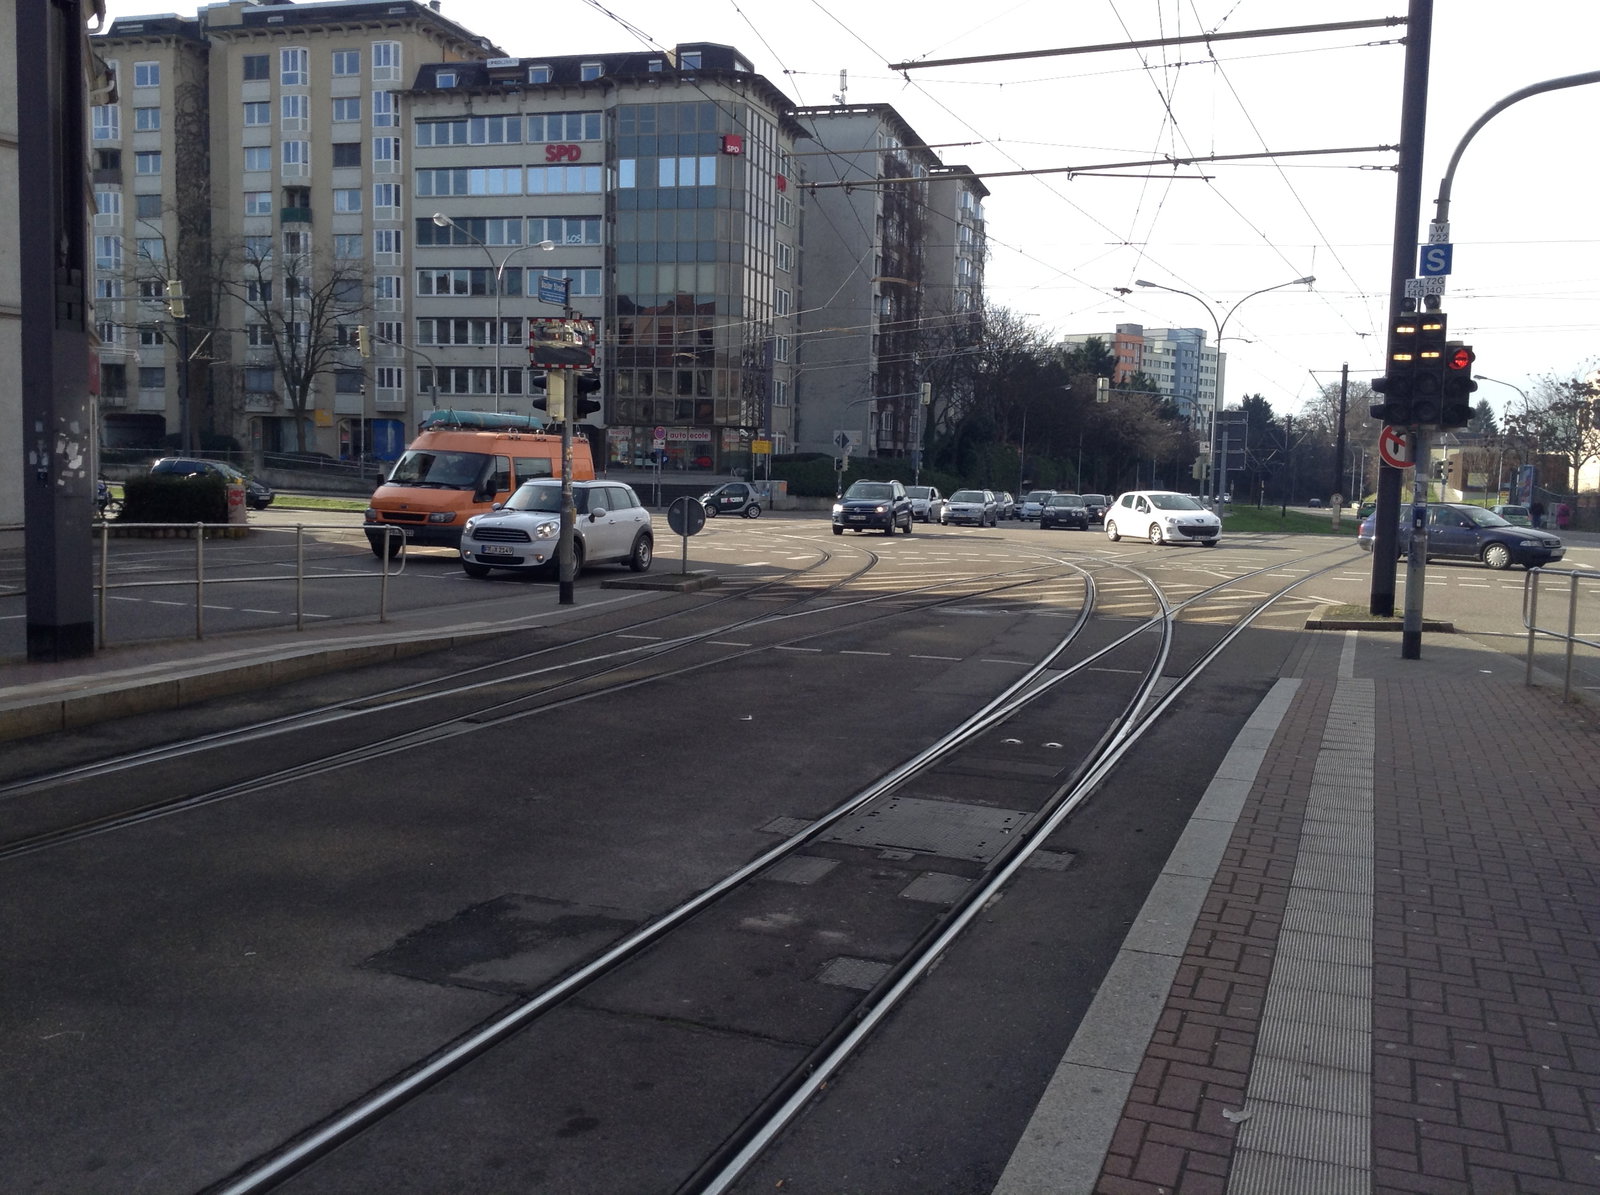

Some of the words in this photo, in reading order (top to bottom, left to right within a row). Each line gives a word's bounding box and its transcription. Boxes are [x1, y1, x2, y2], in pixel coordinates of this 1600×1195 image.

[726, 144, 740, 153] SPD
[545, 144, 582, 162] SPD
[1434, 225, 1446, 233] W
[1430, 234, 1449, 242] 722
[1426, 248, 1446, 272] S
[1406, 281, 1424, 289] 72L
[1426, 286, 1442, 294] 140
[669, 431, 686, 439] auto
